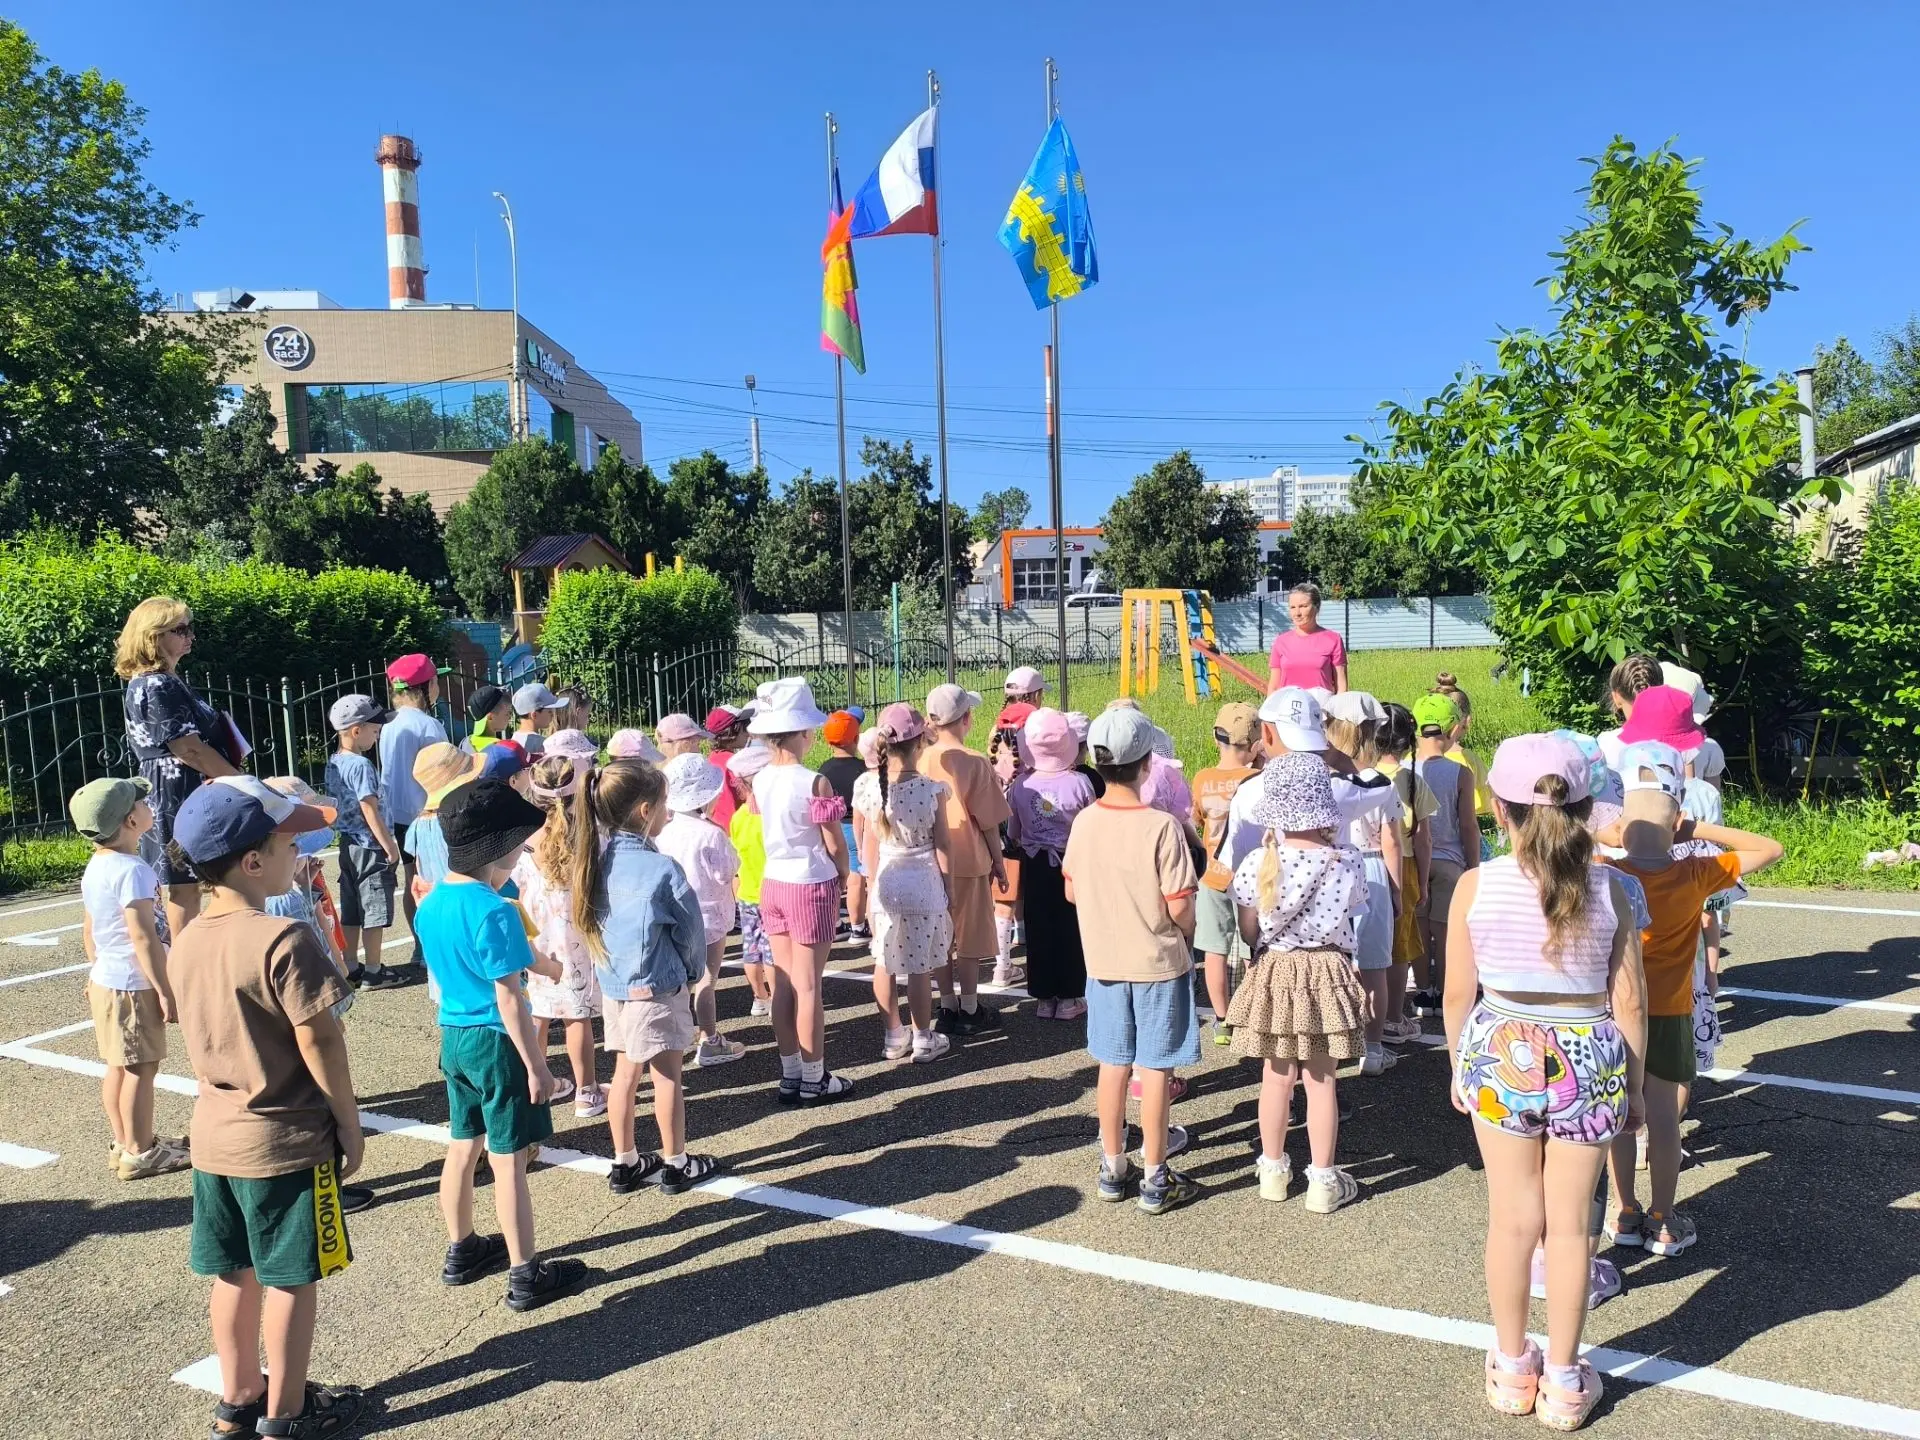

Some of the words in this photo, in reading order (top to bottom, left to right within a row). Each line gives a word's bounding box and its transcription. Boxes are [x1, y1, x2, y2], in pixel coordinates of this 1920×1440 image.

[272, 333, 300, 350] 24
[274, 351, 301, 359] часа
[1291, 700, 1303, 725] EA7
[319, 1193, 338, 1254] MOOD
